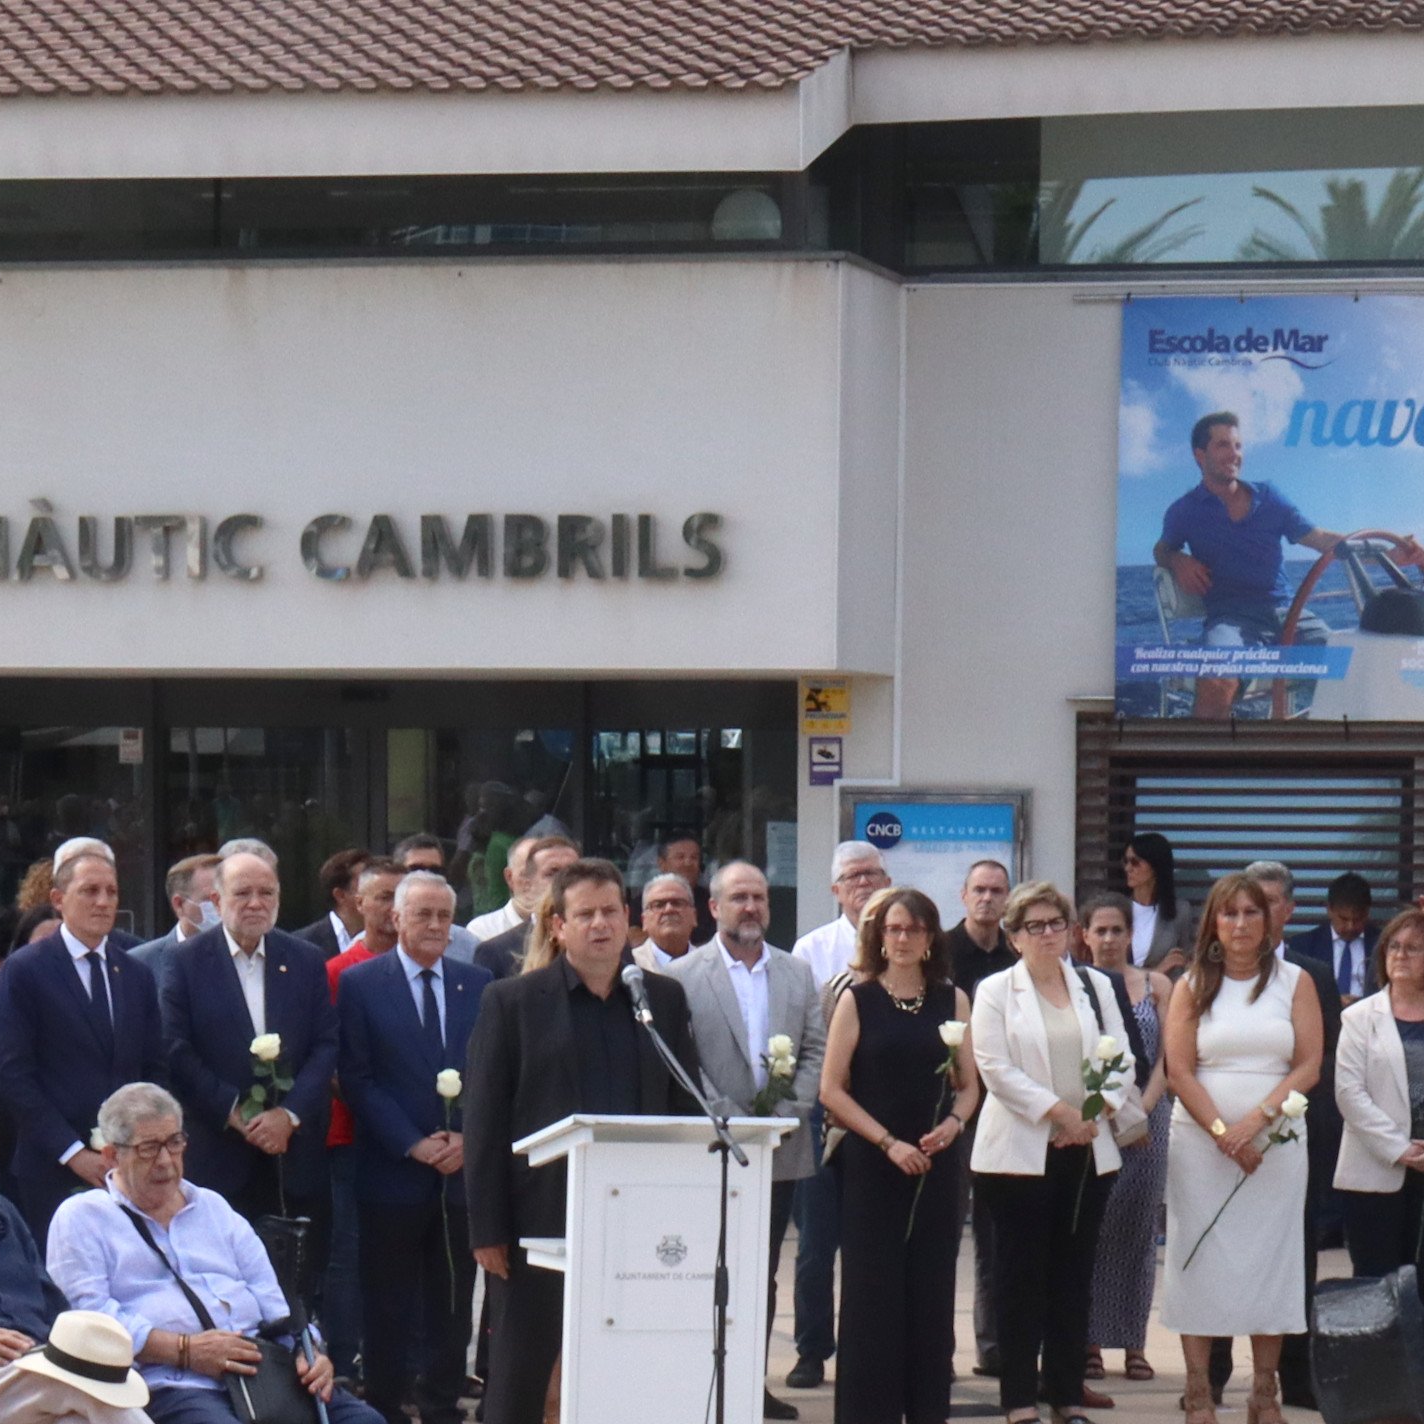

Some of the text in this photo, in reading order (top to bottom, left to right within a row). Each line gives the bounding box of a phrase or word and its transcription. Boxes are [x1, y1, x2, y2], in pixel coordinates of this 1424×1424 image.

[1148, 327, 1328, 353] Escola de Mar
[300, 514, 725, 580] CAMBRILS
[1130, 661, 1328, 676] con nuestras propias embarcaciones
[867, 823, 1005, 836] CNCB RESTAURANT
